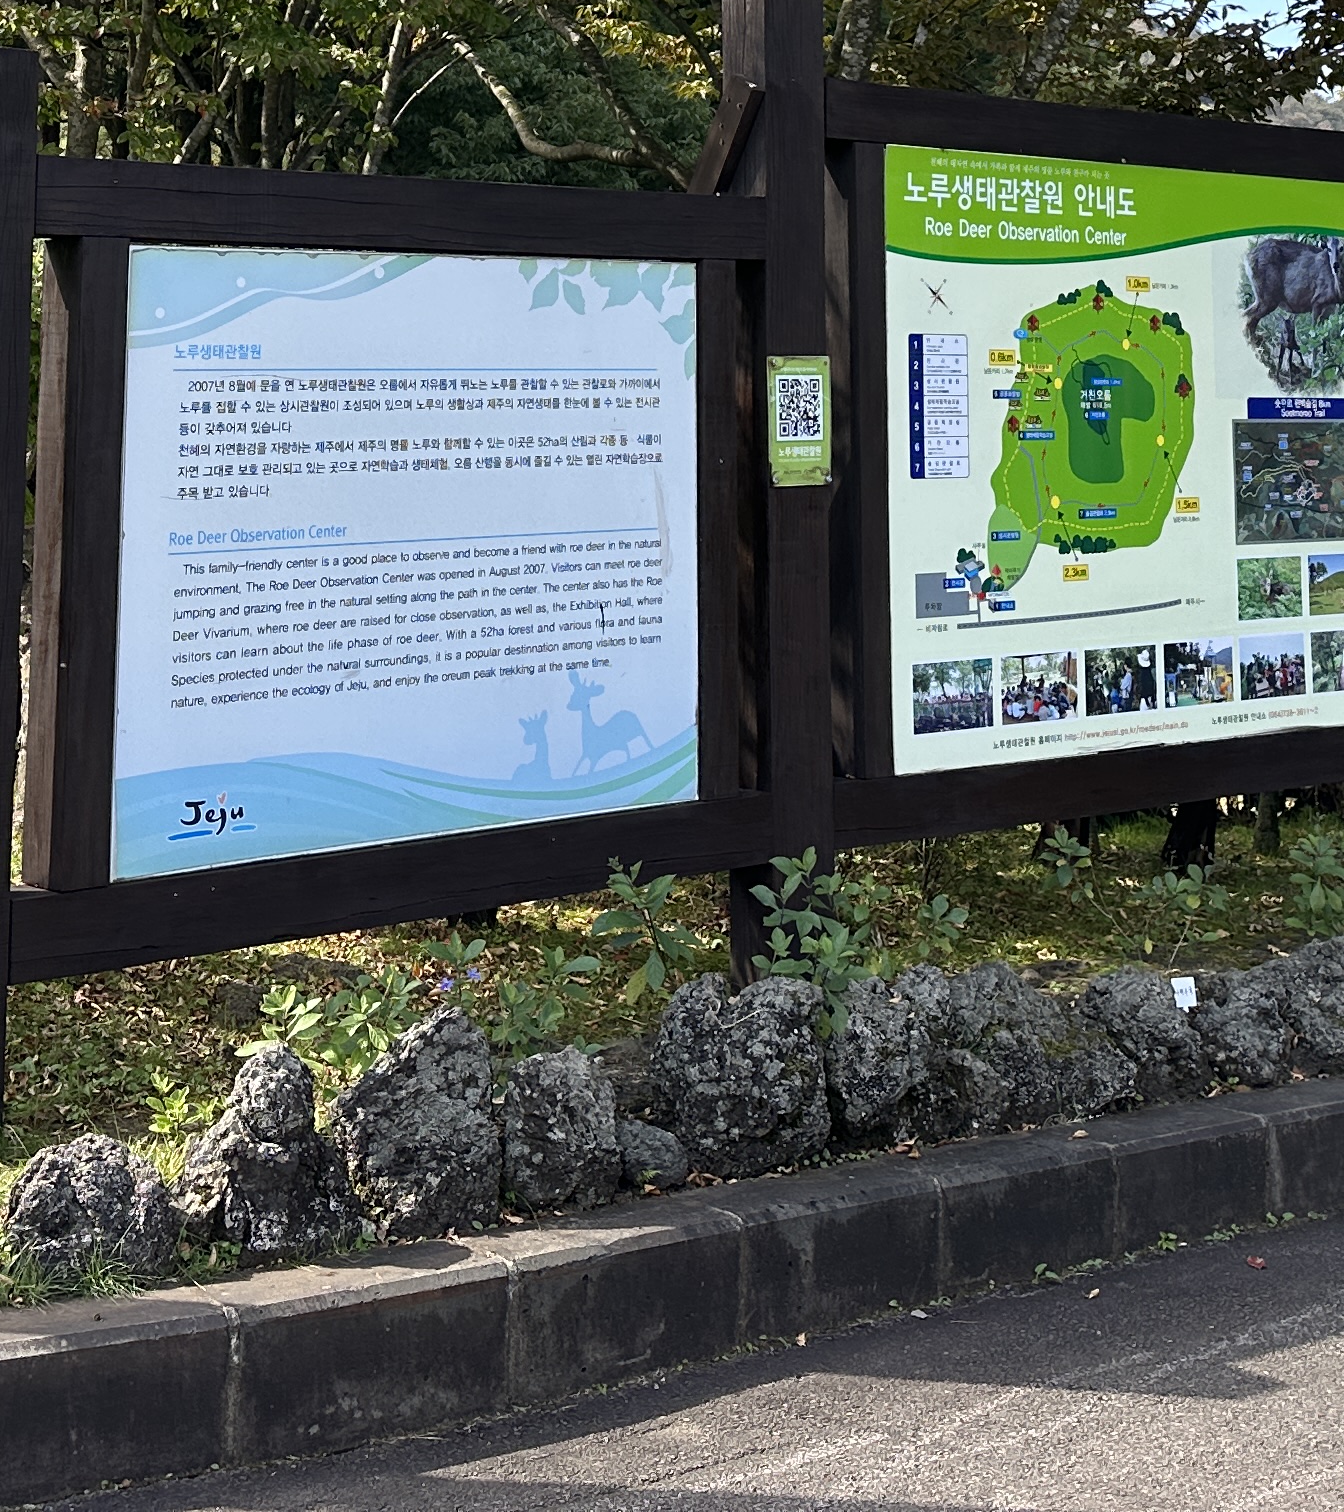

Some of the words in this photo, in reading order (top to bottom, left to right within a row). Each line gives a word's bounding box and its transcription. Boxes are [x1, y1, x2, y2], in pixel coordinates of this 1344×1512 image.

[904, 172, 1063, 214] 노루생태관찰원
[1074, 184, 1136, 219] 안내도
[926, 217, 952, 236] Roe
[960, 219, 991, 238] Deer
[999, 221, 1079, 242] Observation
[1085, 227, 1126, 245] Center
[173, 344, 261, 360] 노루생태관찰원
[913, 341, 918, 349] 1
[914, 361, 919, 369] 2
[914, 382, 919, 390] 3
[914, 402, 919, 410] 4
[914, 422, 920, 431] 5
[914, 463, 920, 472] 7
[1178, 500, 1197, 510] 1.5km
[169, 532, 193, 546] Roe
[197, 530, 227, 544] Deer
[230, 527, 304, 542] Observation
[308, 524, 347, 538] Center
[245, 581, 265, 592] The
[269, 580, 289, 591] Roe
[292, 578, 317, 589] Deer
[320, 574, 378, 587] Observation
[382, 572, 414, 584] Center
[417, 572, 436, 581] was
[438, 567, 474, 581] opened
[477, 567, 486, 577] in
[488, 565, 520, 577] August
[551, 562, 582, 573] Visitors
[584, 562, 601, 571] can
[604, 559, 624, 569] meet
[627, 560, 641, 568] roe
[643, 558, 662, 567] deer
[1065, 568, 1087, 578] 2.3km
[172, 607, 215, 622] jumping
[219, 603, 239, 616] and
[243, 602, 281, 616] grazing
[284, 600, 304, 611] free
[307, 599, 316, 609] in
[320, 597, 336, 608] the
[339, 594, 372, 607] natural
[410, 592, 436, 602] along
[439, 589, 454, 600] the
[457, 587, 478, 601] path
[481, 589, 489, 597] in
[492, 586, 506, 596] the
[542, 582, 560, 593] The
[562, 581, 590, 592] center
[592, 579, 610, 590] also
[612, 578, 628, 588] has
[630, 577, 643, 587] the
[646, 576, 662, 586] Roe
[172, 630, 199, 641] Deer
[256, 623, 288, 635] where
[292, 622, 309, 632] roe
[312, 619, 337, 630] deer
[340, 618, 356, 628] are
[360, 613, 390, 626] raised
[393, 613, 407, 624] for
[410, 611, 436, 623] close
[500, 607, 511, 616] as
[514, 603, 532, 614] well
[552, 601, 566, 612] the
[636, 595, 662, 605] where
[171, 651, 211, 663] visitors
[215, 649, 236, 660] can
[240, 646, 268, 658] learn
[272, 642, 303, 655] about
[307, 640, 324, 652] the
[328, 638, 343, 650] life
[347, 637, 378, 651] phase
[382, 634, 392, 646] of
[180, 798, 244, 835] Jeju
